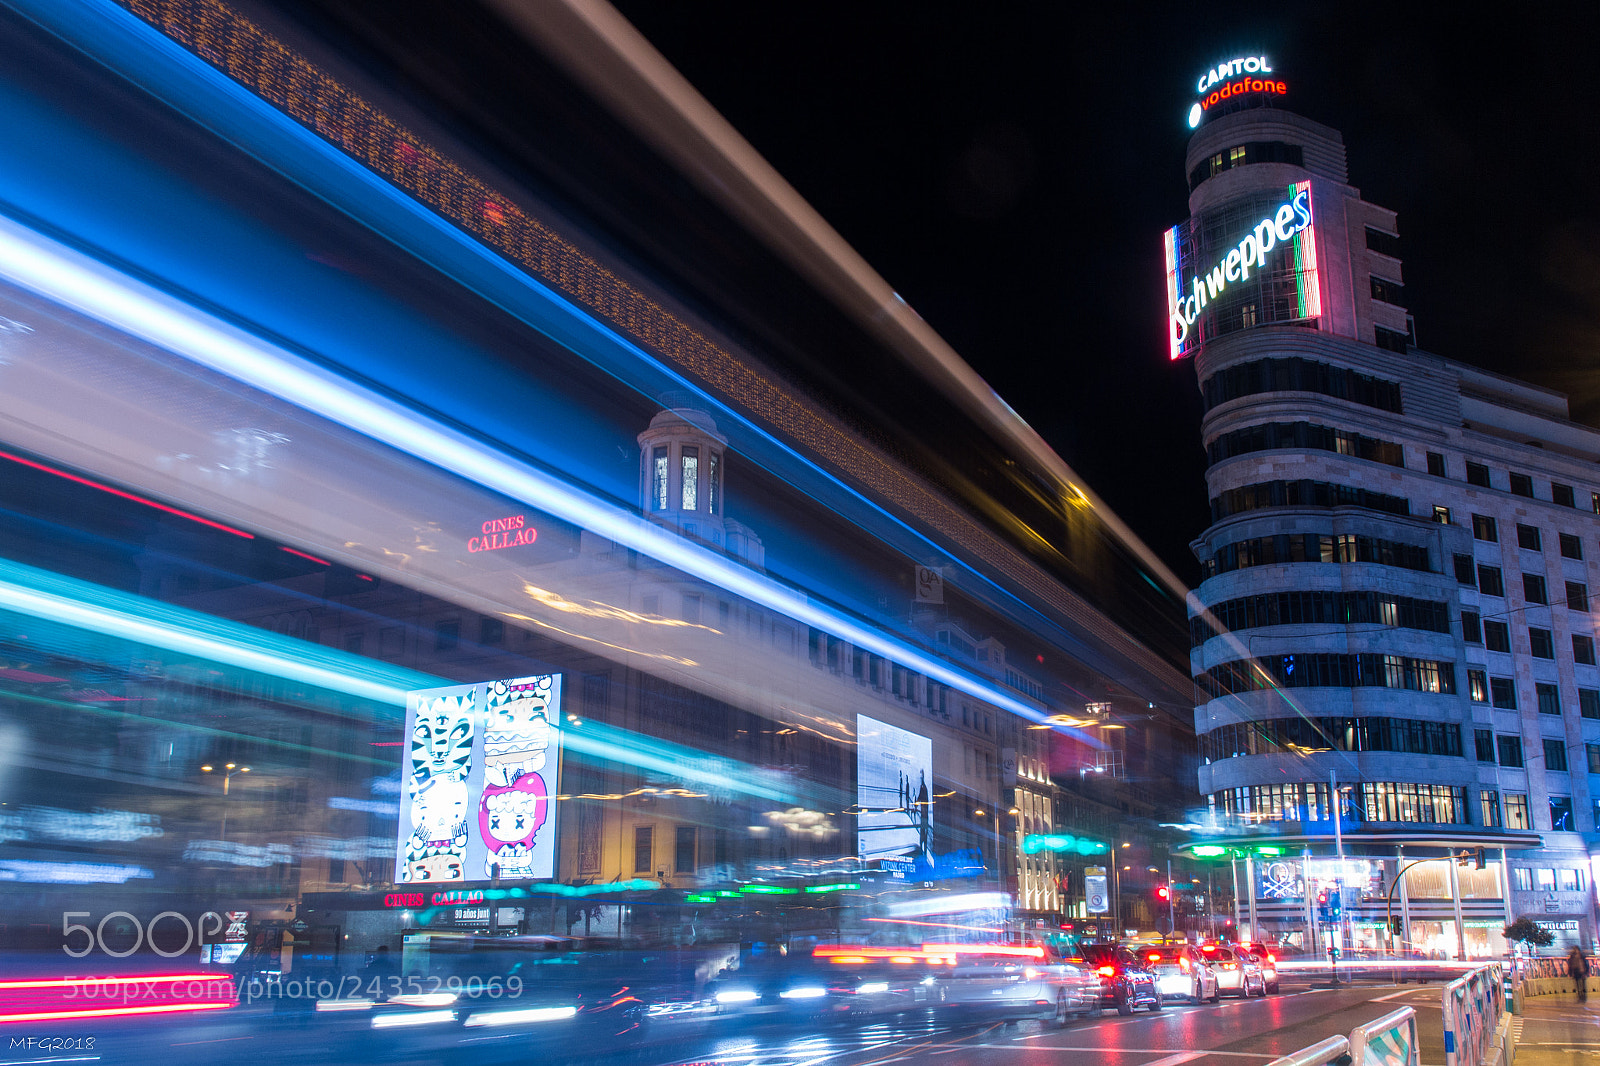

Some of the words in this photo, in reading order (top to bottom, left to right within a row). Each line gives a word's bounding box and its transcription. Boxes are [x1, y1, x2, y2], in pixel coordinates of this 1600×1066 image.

[1198, 56, 1272, 93] CAPITOL
[1201, 76, 1287, 111] vodafone
[1171, 190, 1312, 346] Schweppes
[481, 515, 525, 535] CINES
[467, 527, 538, 553] CALLAO
[899, 862, 916, 873] CENTER
[384, 893, 424, 907] CINES
[432, 890, 484, 906] CALLAO
[454, 909, 463, 919] 90
[463, 908, 477, 919] años
